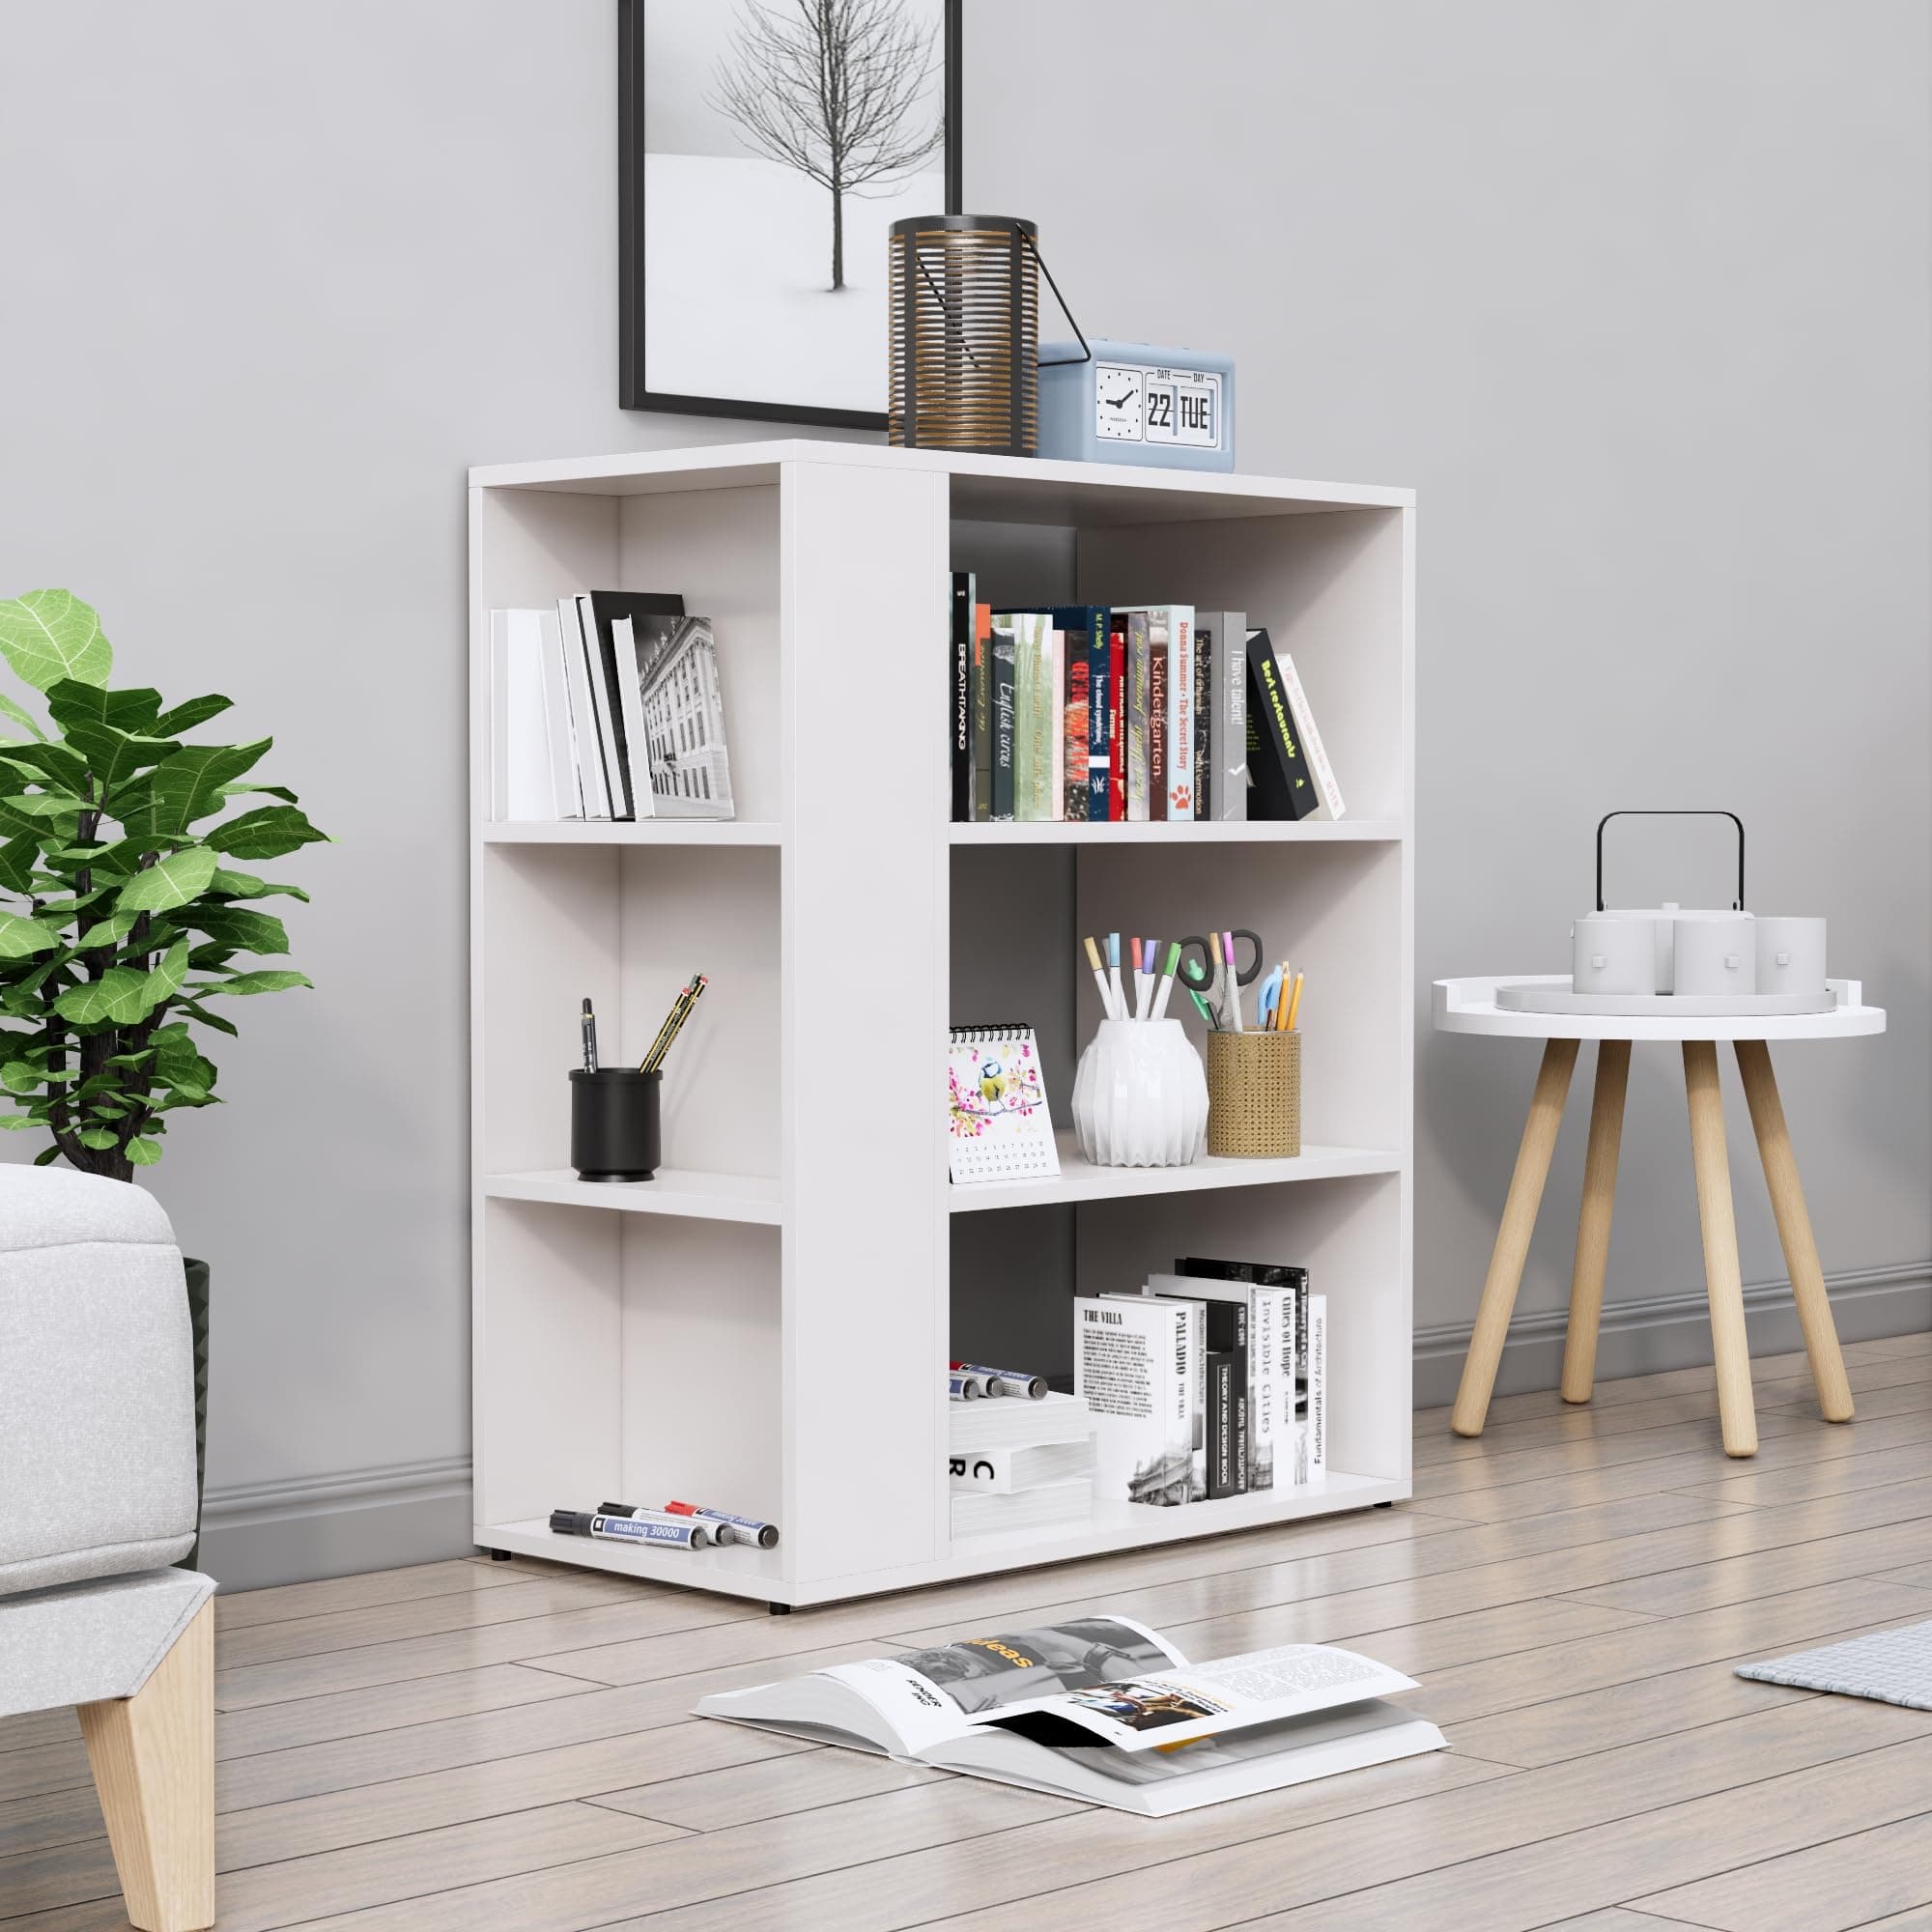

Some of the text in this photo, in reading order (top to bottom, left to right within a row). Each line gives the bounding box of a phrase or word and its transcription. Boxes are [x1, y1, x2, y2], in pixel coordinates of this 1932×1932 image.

[1157, 369, 1170, 380] DATE
[1193, 373, 1205, 383] DAY
[1148, 393, 1170, 426] 22
[1180, 396, 1208, 429] TUE
[1195, 638, 1204, 654] The
[1195, 655, 1204, 668] art
[1095, 675, 1104, 688] The
[1130, 657, 1147, 716] premium
[1195, 668, 1204, 678] of
[1231, 658, 1244, 685] have
[957, 643, 967, 751] BREATHTAKING
[1095, 689, 1104, 708] cloud
[1176, 621, 1189, 771] Donna Summer The Secret Story
[1231, 689, 1244, 725] talent!
[1260, 659, 1297, 758] Best restaurants
[994, 682, 1014, 770] English circus
[1151, 656, 1165, 776] Kindergarten
[1083, 1310, 1122, 1325] THE VILLA
[1176, 1312, 1187, 1376] PALLADIO
[1280, 1296, 1293, 1378] Cities of Hope
[1313, 1318, 1322, 1377] Architecture
[1262, 1300, 1272, 1435] Invisible Cities
[1314, 1391, 1322, 1464] Fundamentals
[614, 1521, 680, 1539] making 30000
[912, 1692, 931, 1707] ING
